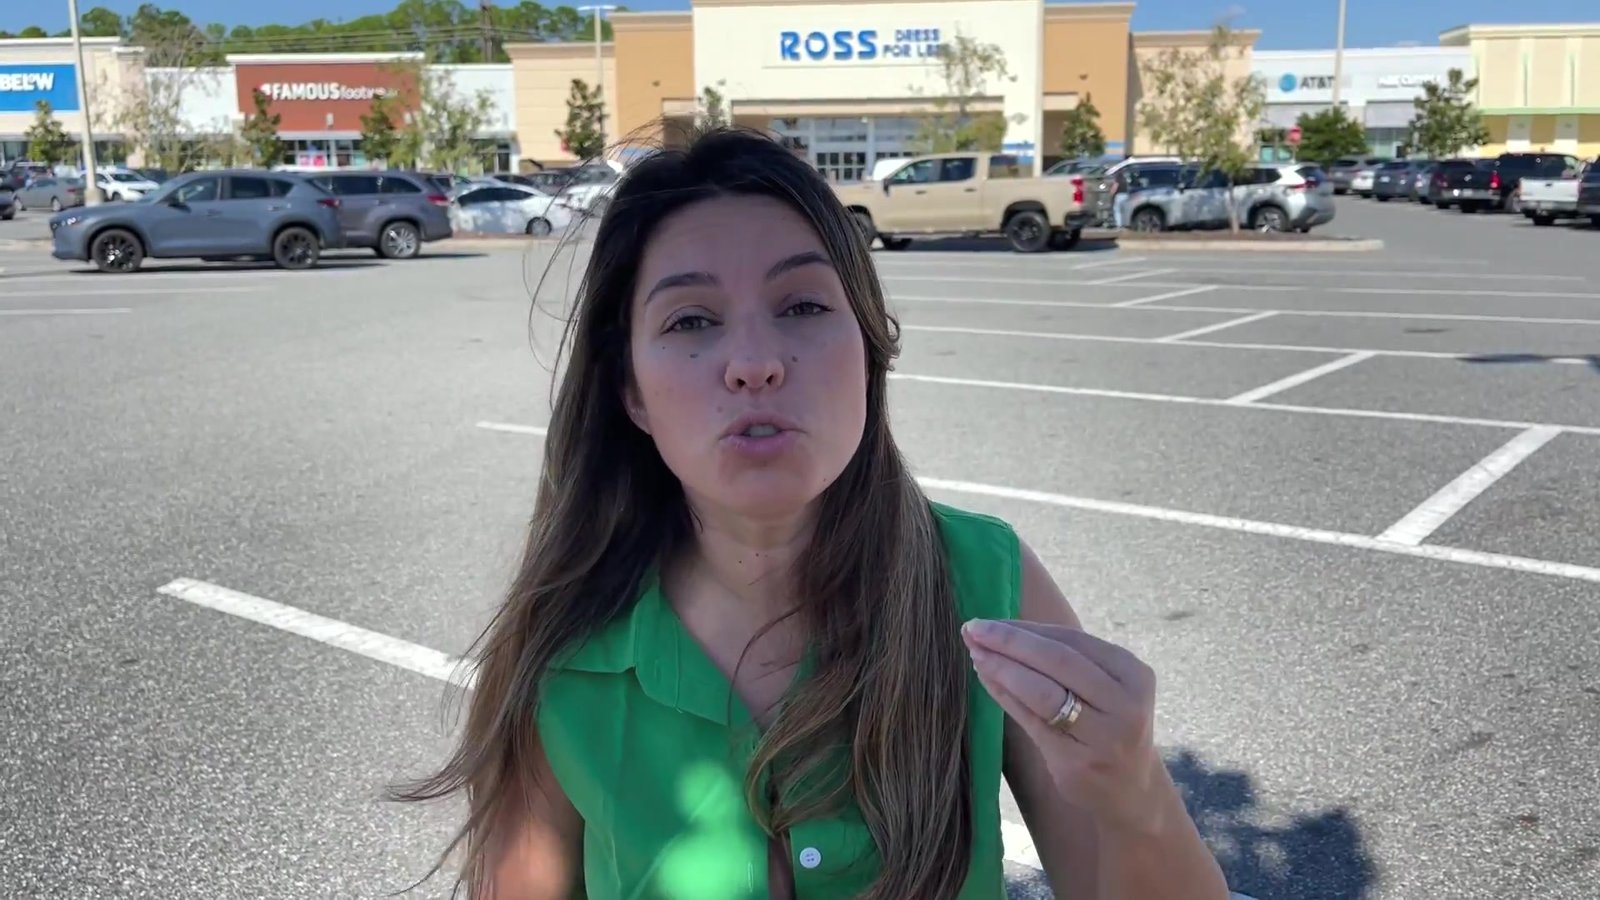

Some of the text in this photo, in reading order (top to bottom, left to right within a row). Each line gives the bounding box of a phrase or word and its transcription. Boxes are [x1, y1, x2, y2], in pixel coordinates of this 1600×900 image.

[895, 28, 940, 42] DRESS
[780, 30, 878, 61] ROSS
[882, 43, 952, 58] FOR LE
[0, 72, 55, 91] BELOW
[1300, 75, 1336, 89] AT&T
[271, 82, 341, 100] FAMOUS
